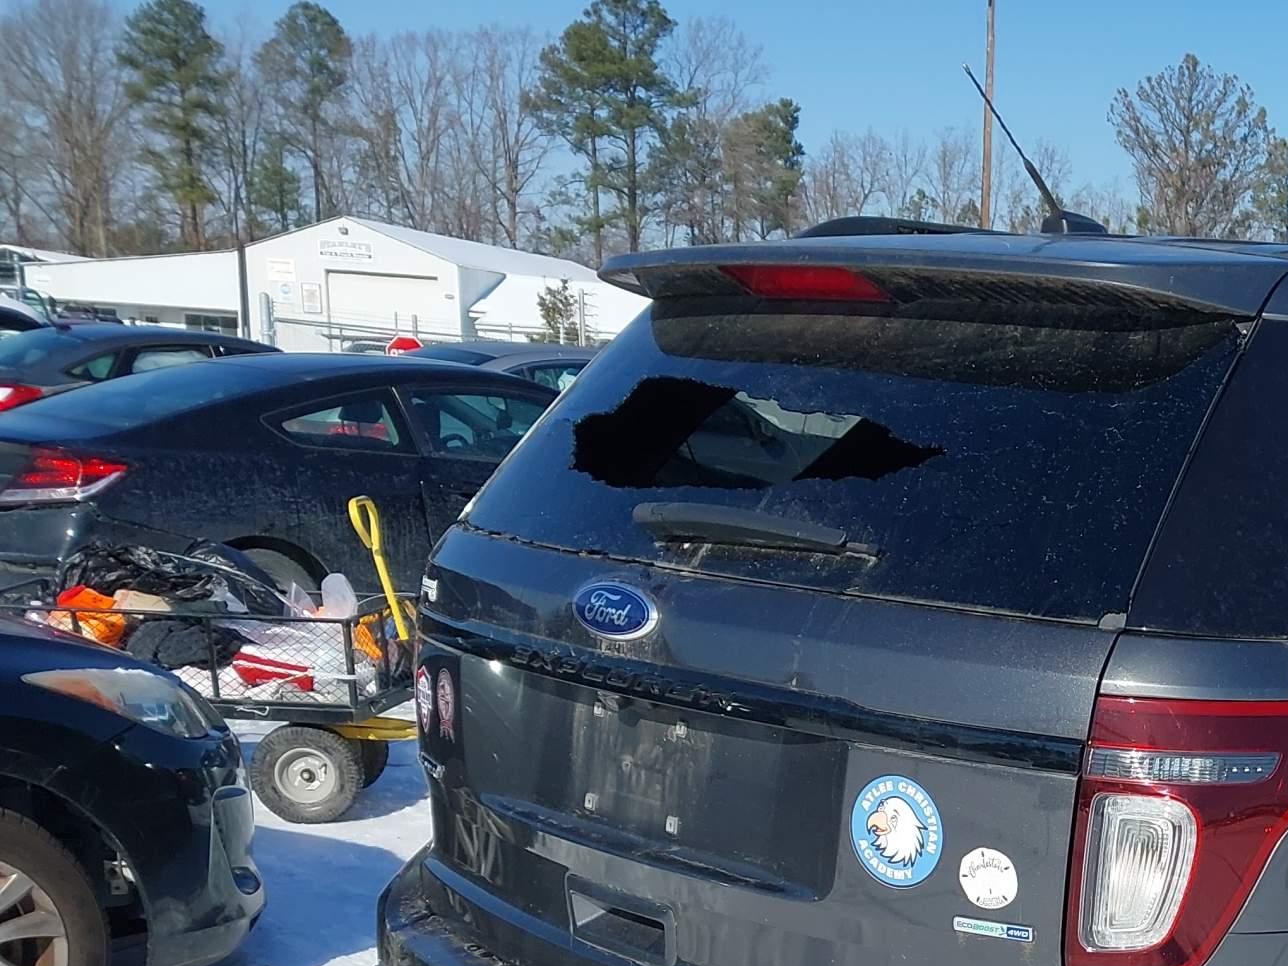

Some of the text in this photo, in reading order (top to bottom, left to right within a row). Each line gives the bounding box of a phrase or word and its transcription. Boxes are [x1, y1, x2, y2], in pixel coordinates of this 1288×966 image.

[584, 590, 632, 626] Ford
[860, 780, 938, 855] ATLEE CHRISTIAN
[857, 840, 913, 880] ACADEMY
[1006, 928, 1029, 938] 4WD
